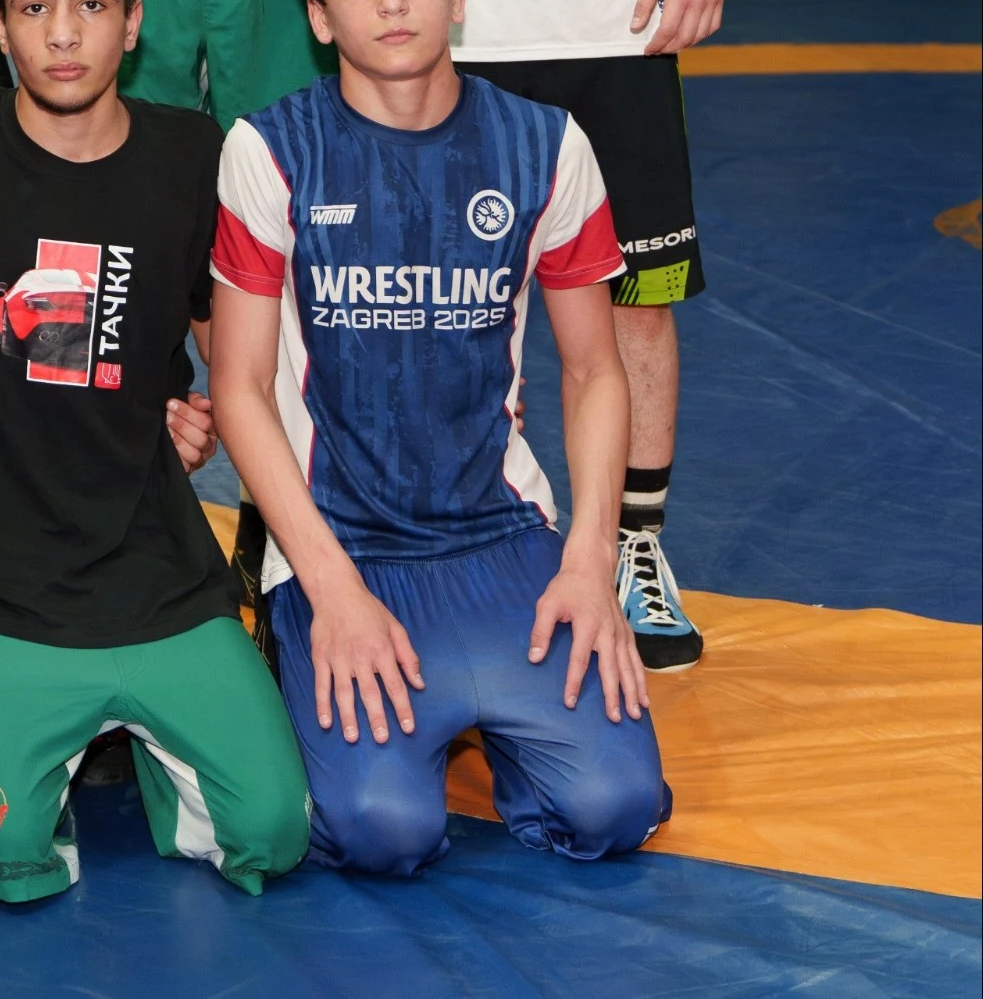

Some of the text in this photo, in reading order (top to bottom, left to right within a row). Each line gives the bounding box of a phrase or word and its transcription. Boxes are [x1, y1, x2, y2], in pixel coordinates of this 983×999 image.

[98, 245, 134, 356] ТАЧКИ
[310, 265, 512, 305] WRESTLING
[311, 306, 506, 331] ZAGREB 2025
